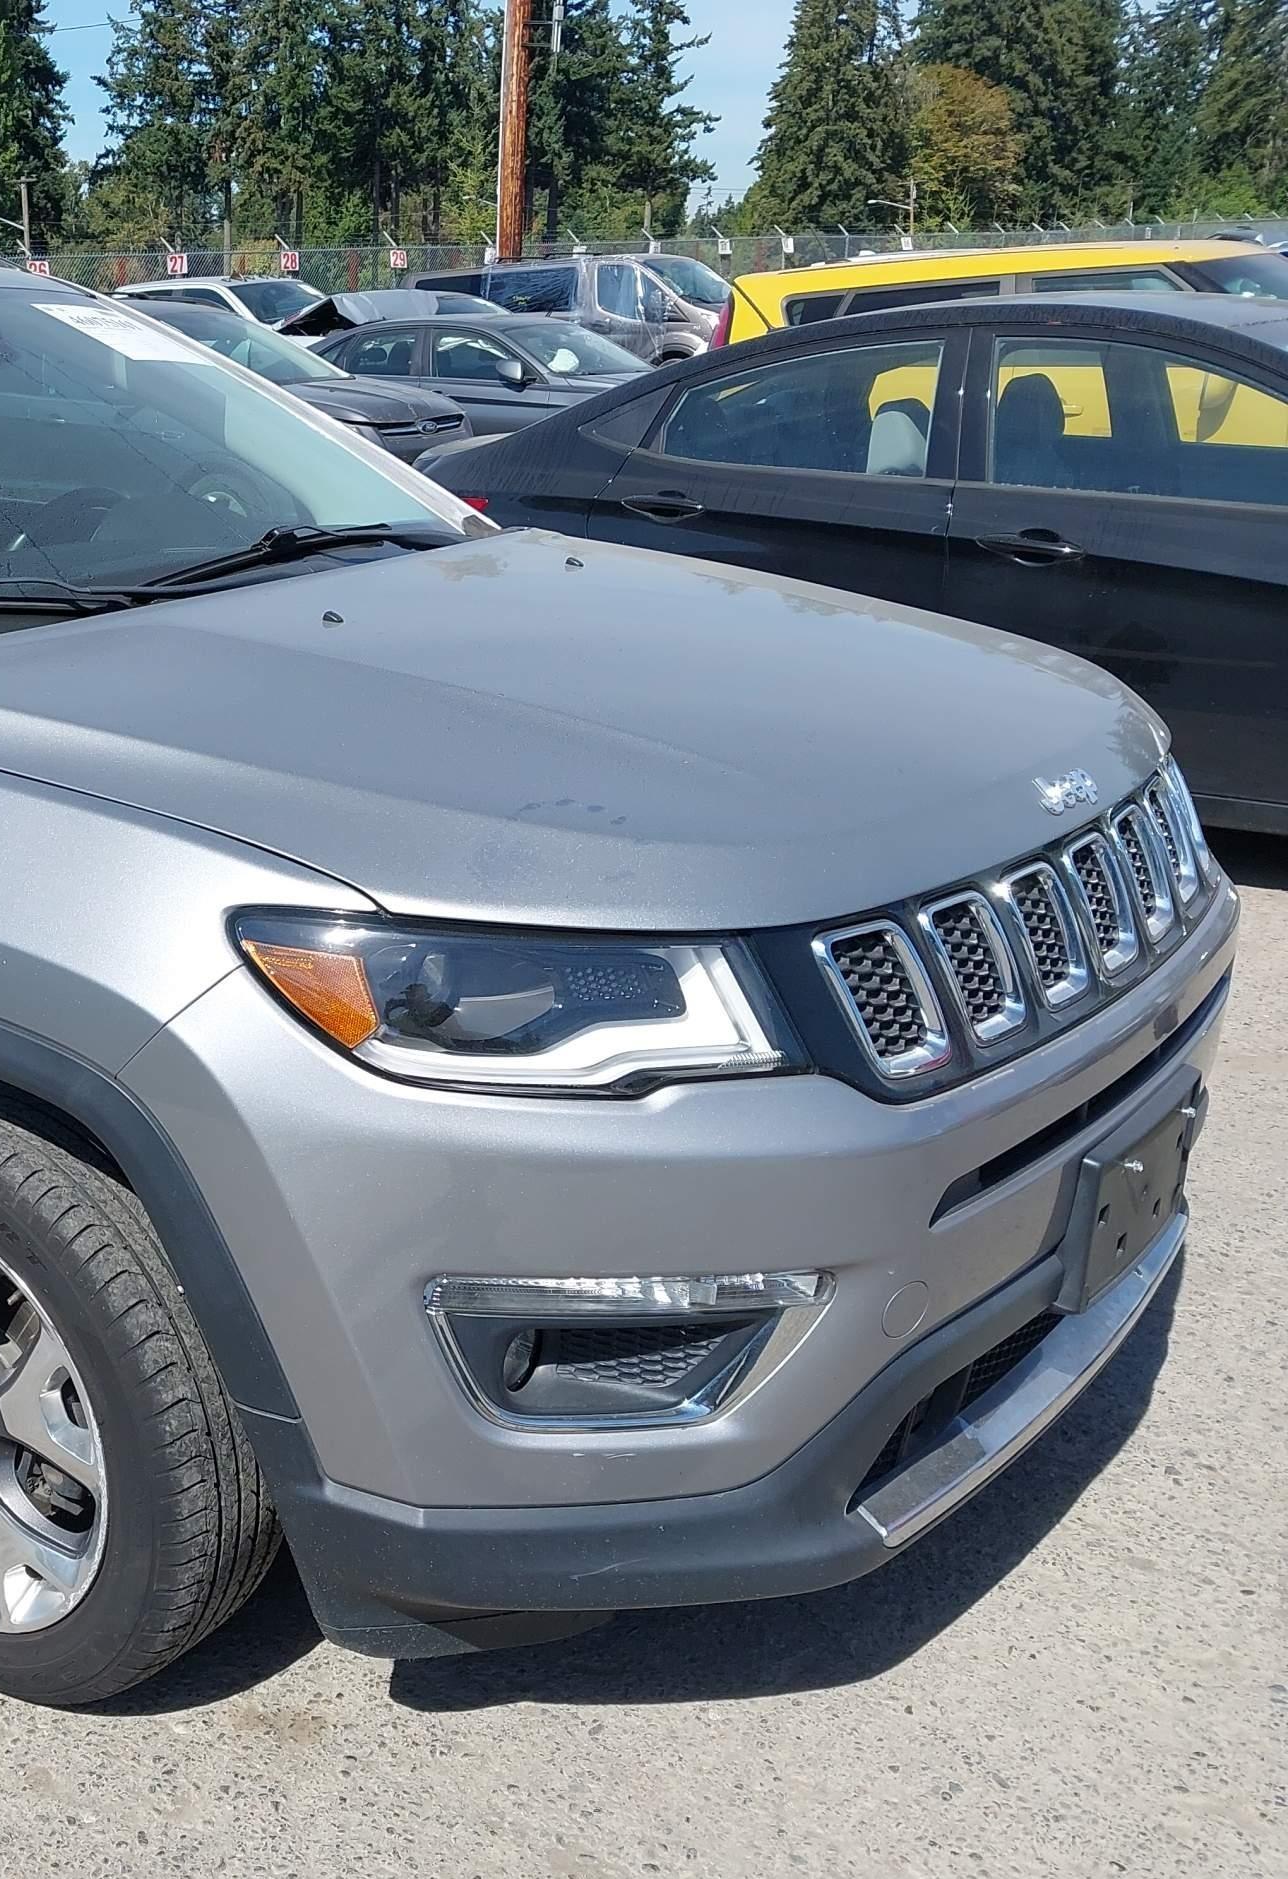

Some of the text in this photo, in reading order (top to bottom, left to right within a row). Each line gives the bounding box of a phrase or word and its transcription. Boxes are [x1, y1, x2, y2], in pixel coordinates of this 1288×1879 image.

[170, 255, 185, 272] 27
[283, 253, 297, 269] 28
[392, 251, 406, 266] 29
[1032, 768, 1098, 816] Jeep
